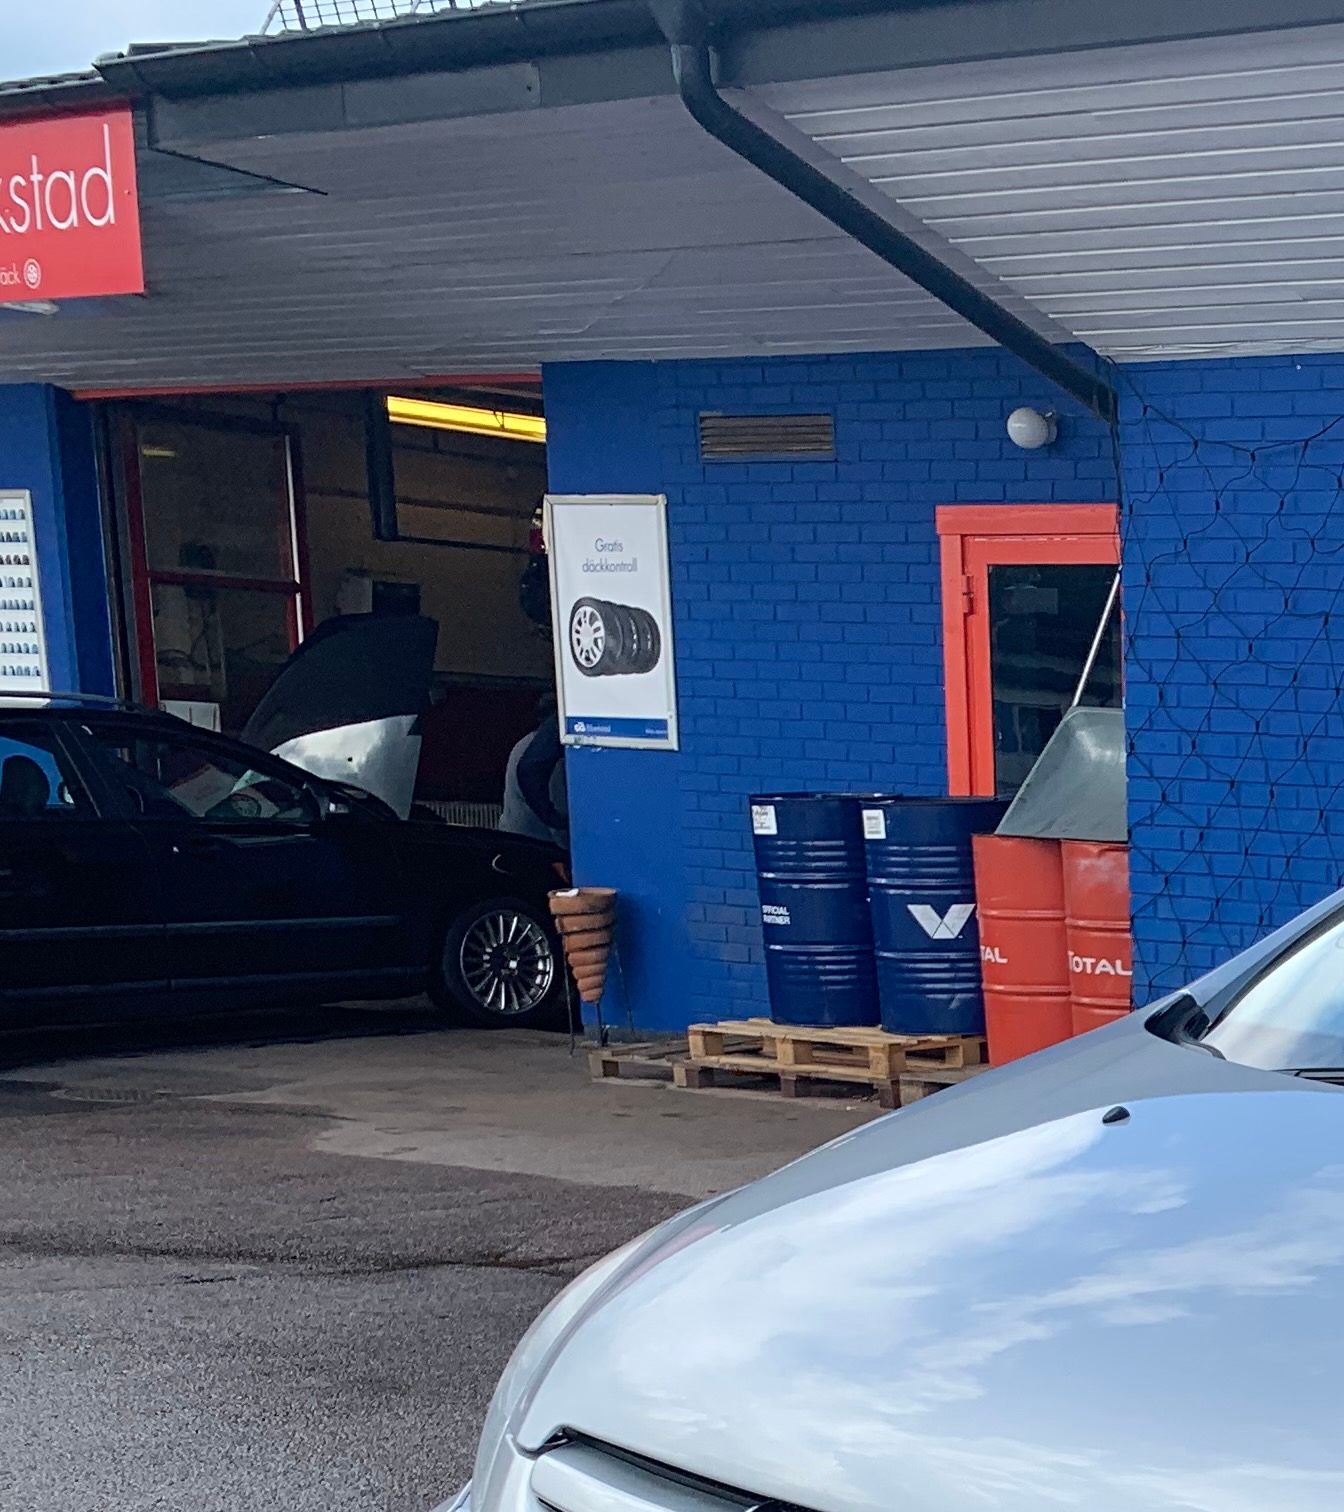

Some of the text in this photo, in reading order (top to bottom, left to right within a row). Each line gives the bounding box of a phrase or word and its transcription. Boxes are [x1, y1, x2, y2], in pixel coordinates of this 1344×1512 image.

[594, 537, 624, 552] Gratis
[582, 557, 638, 573] däckkontroll
[1068, 950, 1133, 976] TOTAL
